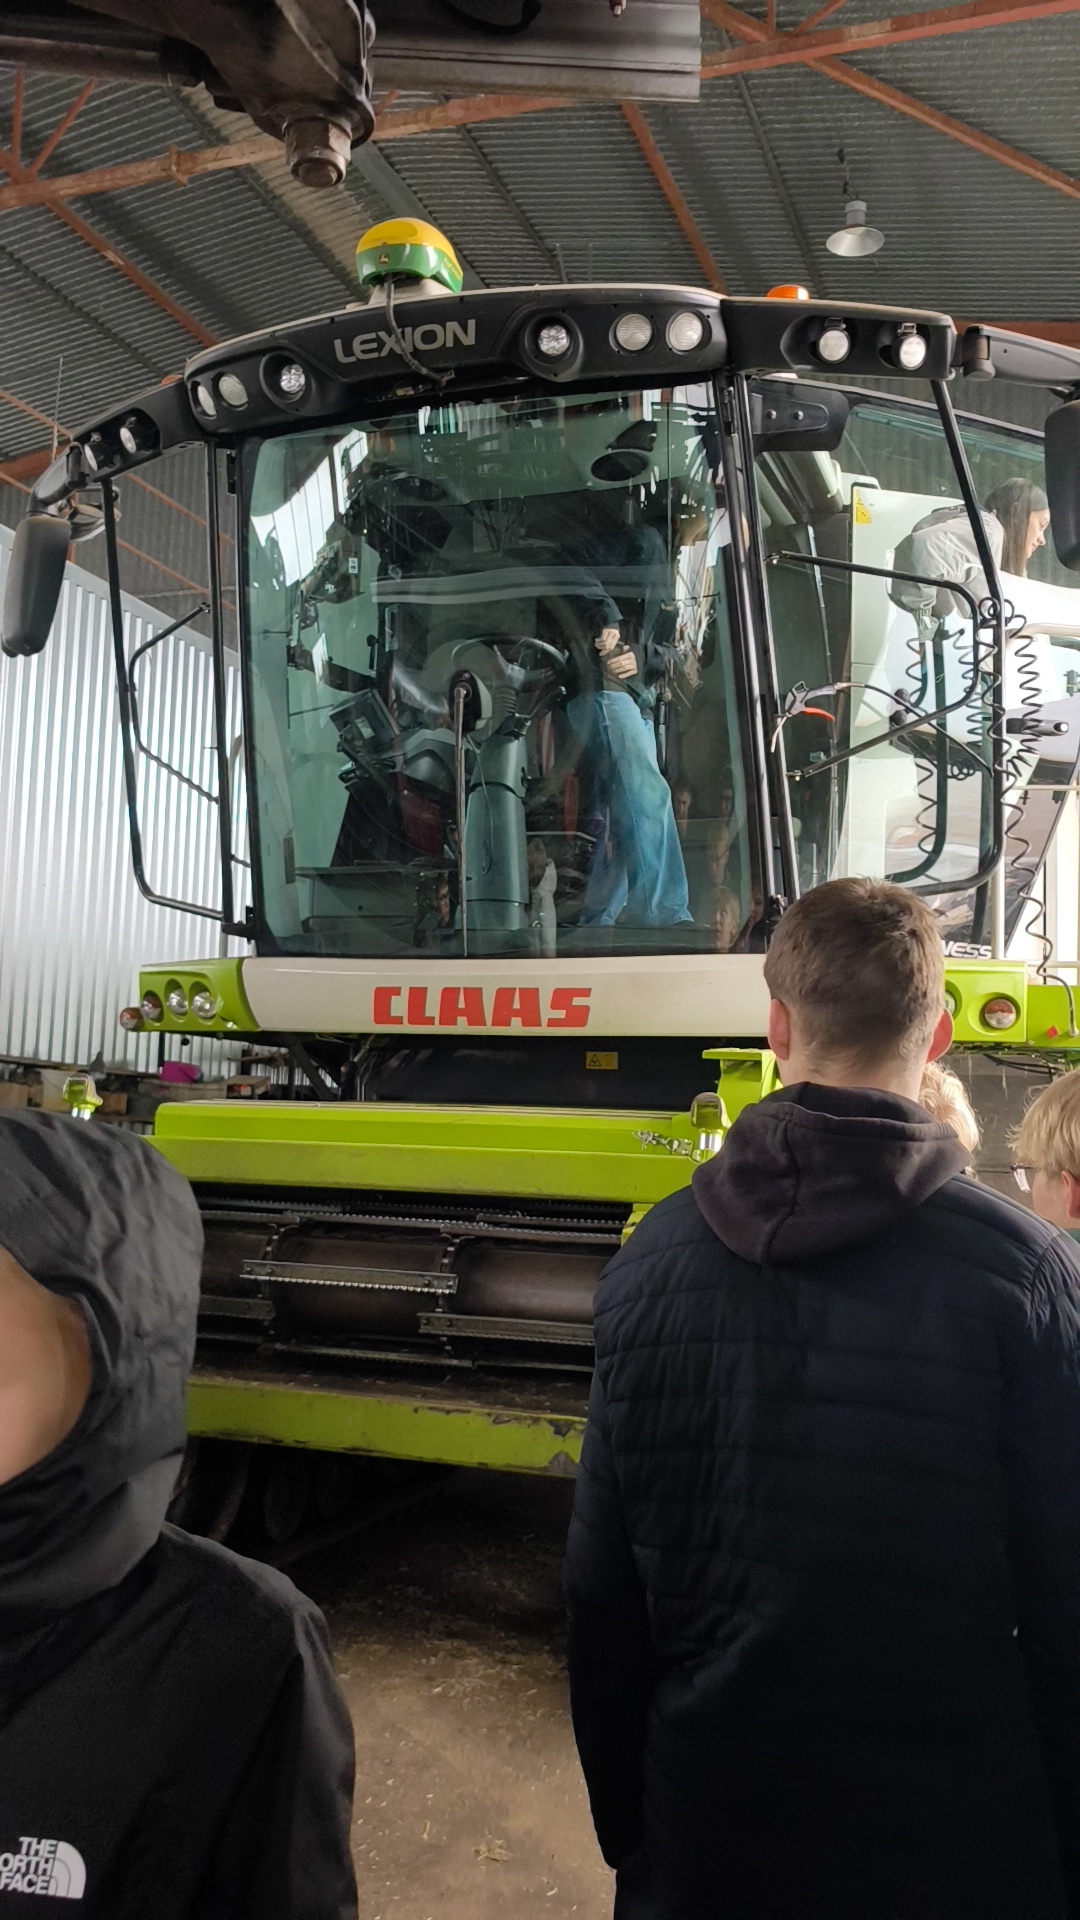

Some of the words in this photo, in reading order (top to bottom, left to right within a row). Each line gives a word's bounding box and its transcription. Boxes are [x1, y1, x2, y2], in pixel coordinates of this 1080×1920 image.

[333, 319, 476, 364] LEXION
[373, 986, 592, 1028] CLAAS
[19, 1836, 58, 1858] THE
[0, 1852, 54, 1877] ORTH
[0, 1871, 50, 1895] FACE
